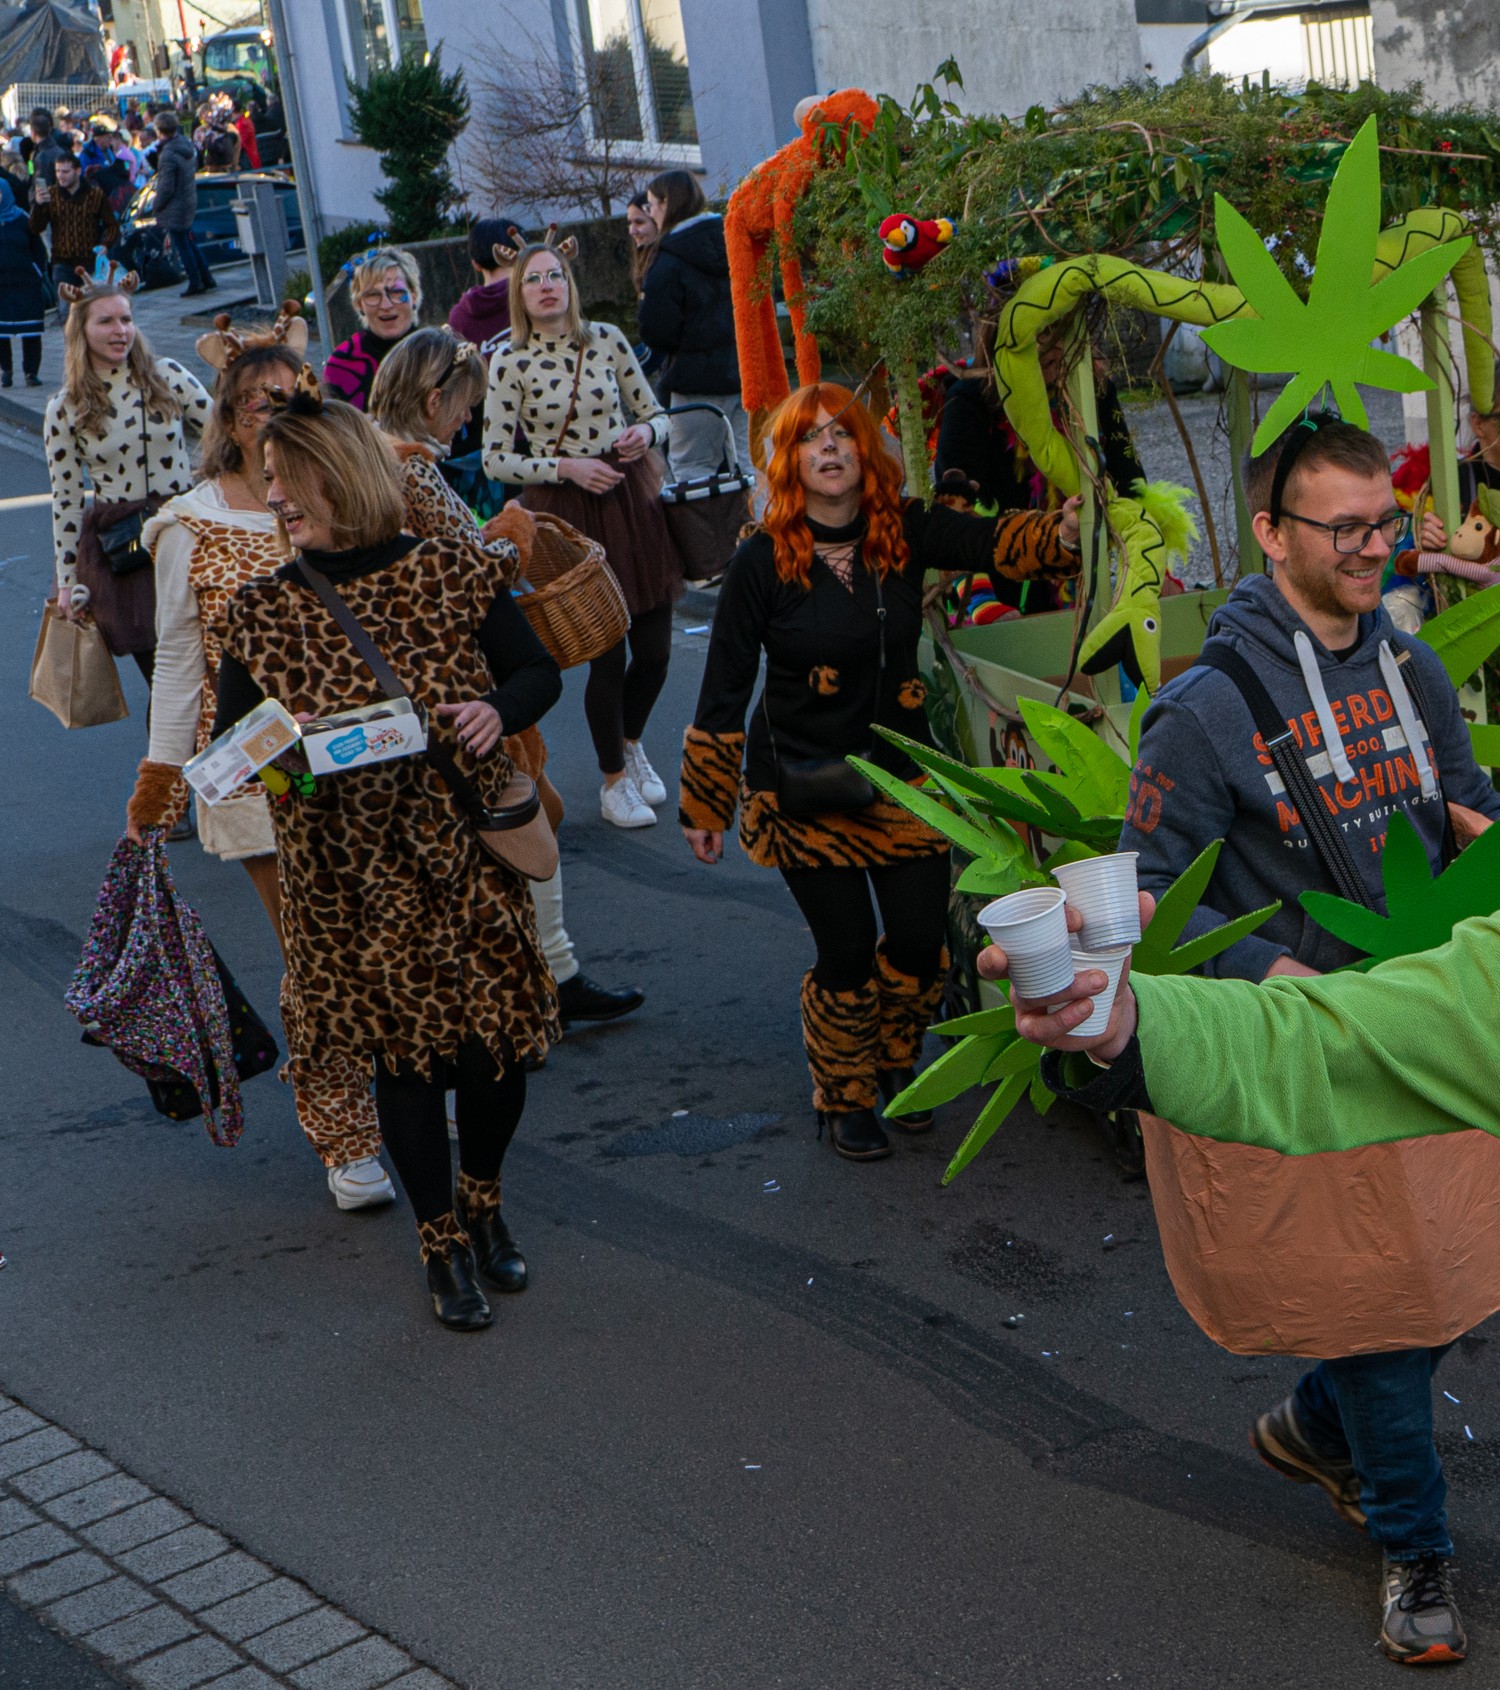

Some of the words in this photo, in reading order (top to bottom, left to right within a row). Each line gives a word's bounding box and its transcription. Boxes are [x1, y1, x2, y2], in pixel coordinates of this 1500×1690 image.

[1252, 687, 1410, 766] SPERD
[1135, 758, 1176, 793] EAM
[1283, 817, 1362, 849] QUTY
